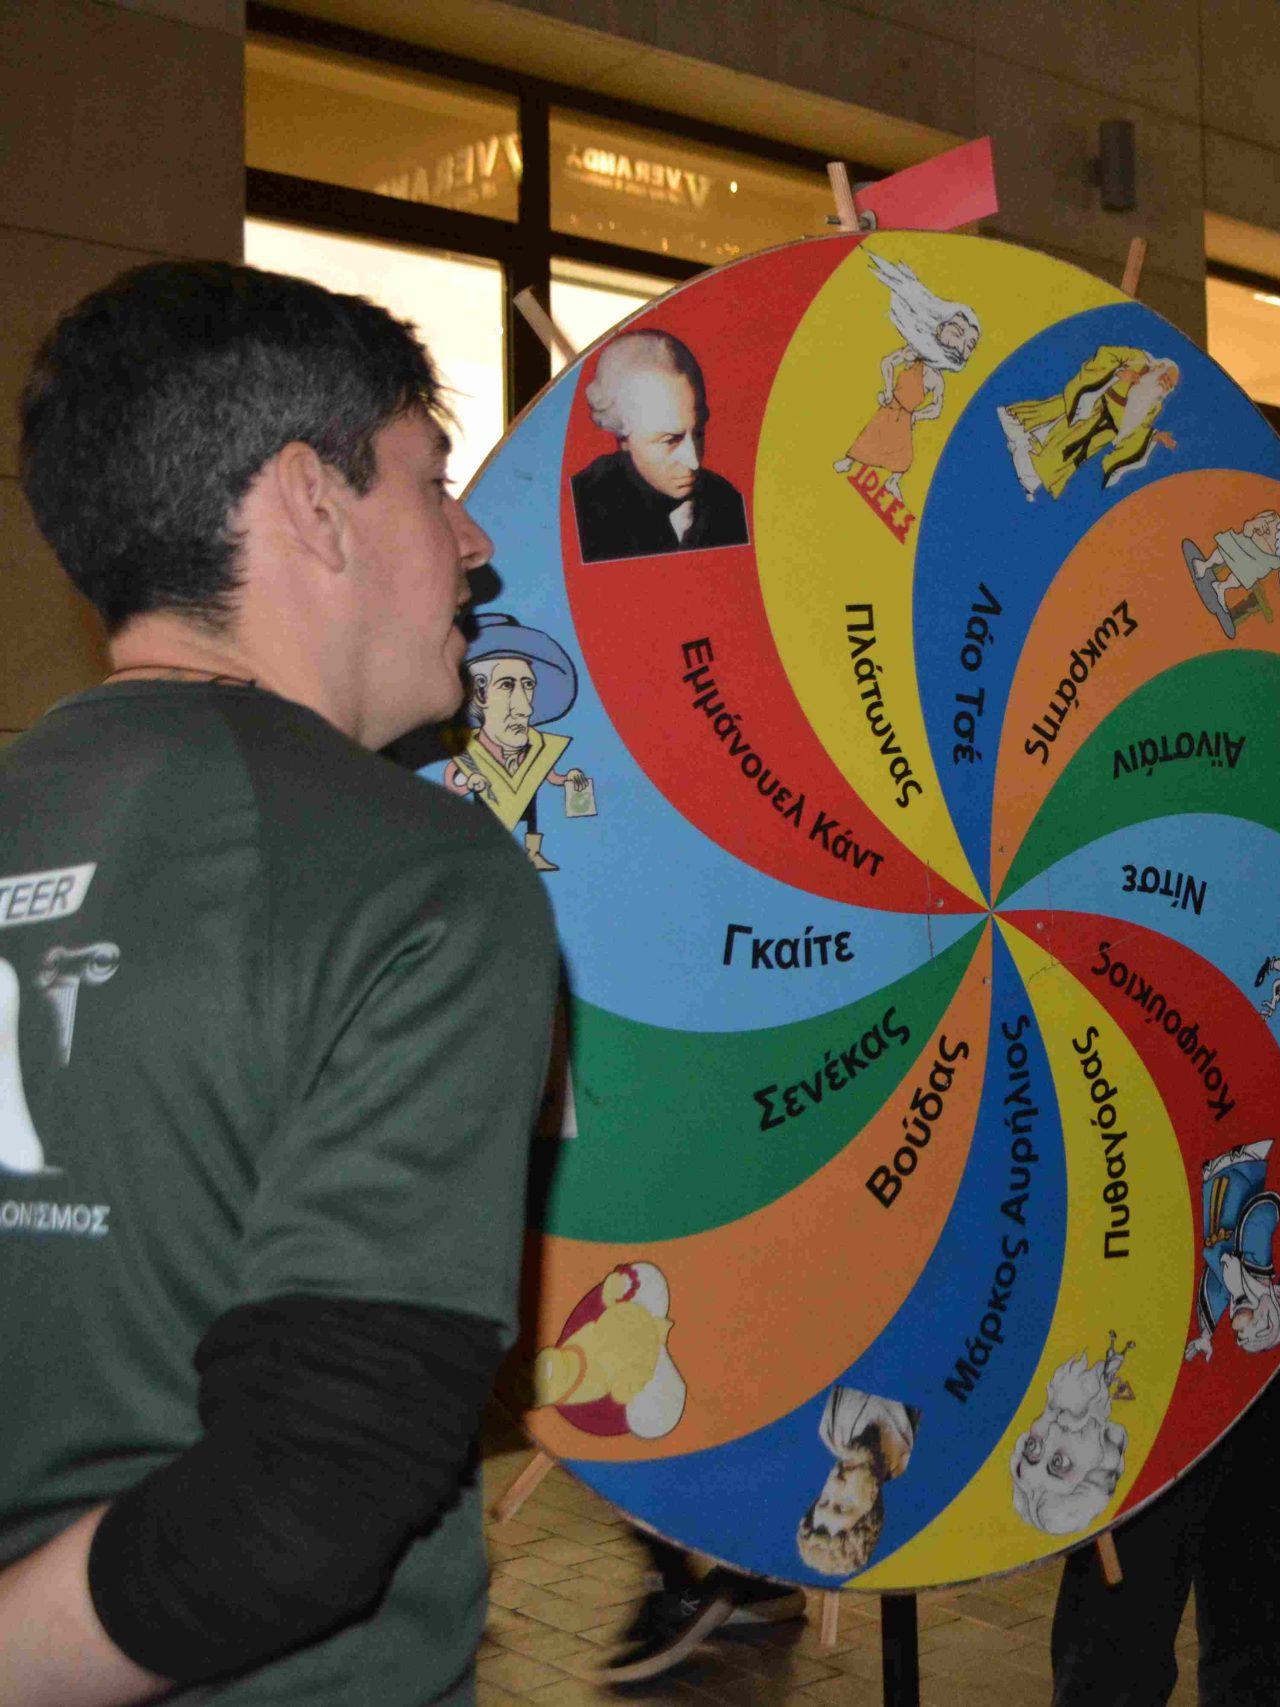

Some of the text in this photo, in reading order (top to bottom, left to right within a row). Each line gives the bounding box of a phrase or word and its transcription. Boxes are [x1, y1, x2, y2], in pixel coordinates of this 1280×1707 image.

[682, 638, 884, 877] Εμμάνουελ Κάντ
[845, 604, 923, 808] Πλάτωνας
[952, 582, 1003, 765] Λάο Τσέ
[1024, 600, 1138, 765] Σωκράτης
[1113, 730, 1246, 780] Αϊνστάιν
[723, 924, 854, 970] Γκαίτε
[1121, 864, 1207, 916] Νίτσε
[751, 1005, 912, 1133] Σενέκας
[1091, 942, 1236, 1122] Κομφούκιος
[865, 1034, 969, 1209] Βούδας
[943, 1014, 1040, 1404] Μάρκος Αυρήλιος
[1072, 1026, 1130, 1259] Πυθαγόρας
